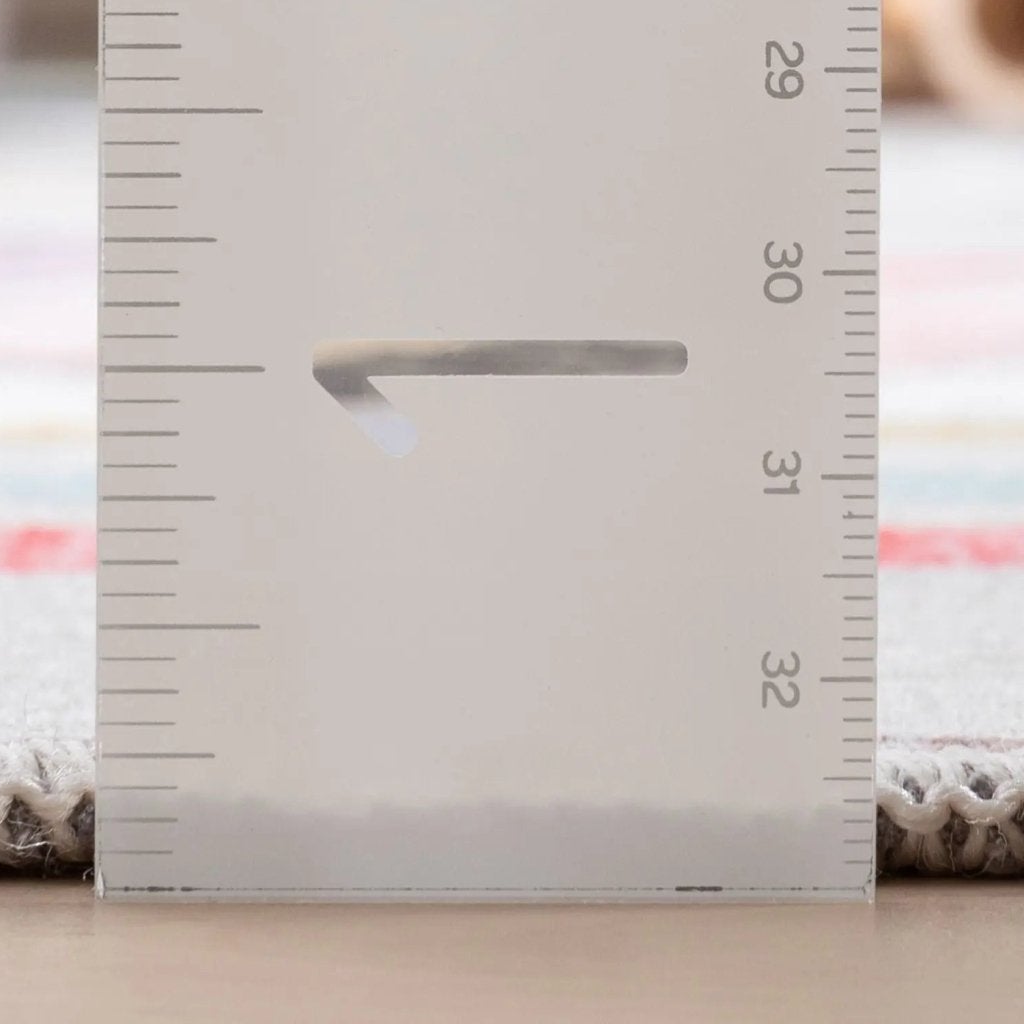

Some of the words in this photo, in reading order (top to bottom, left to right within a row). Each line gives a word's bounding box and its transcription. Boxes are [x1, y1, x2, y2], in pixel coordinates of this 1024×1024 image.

[764, 40, 805, 100] 29
[763, 240, 804, 305] 30
[312, 339, 689, 458] 1
[762, 450, 802, 497] 31
[760, 650, 802, 710] 32
